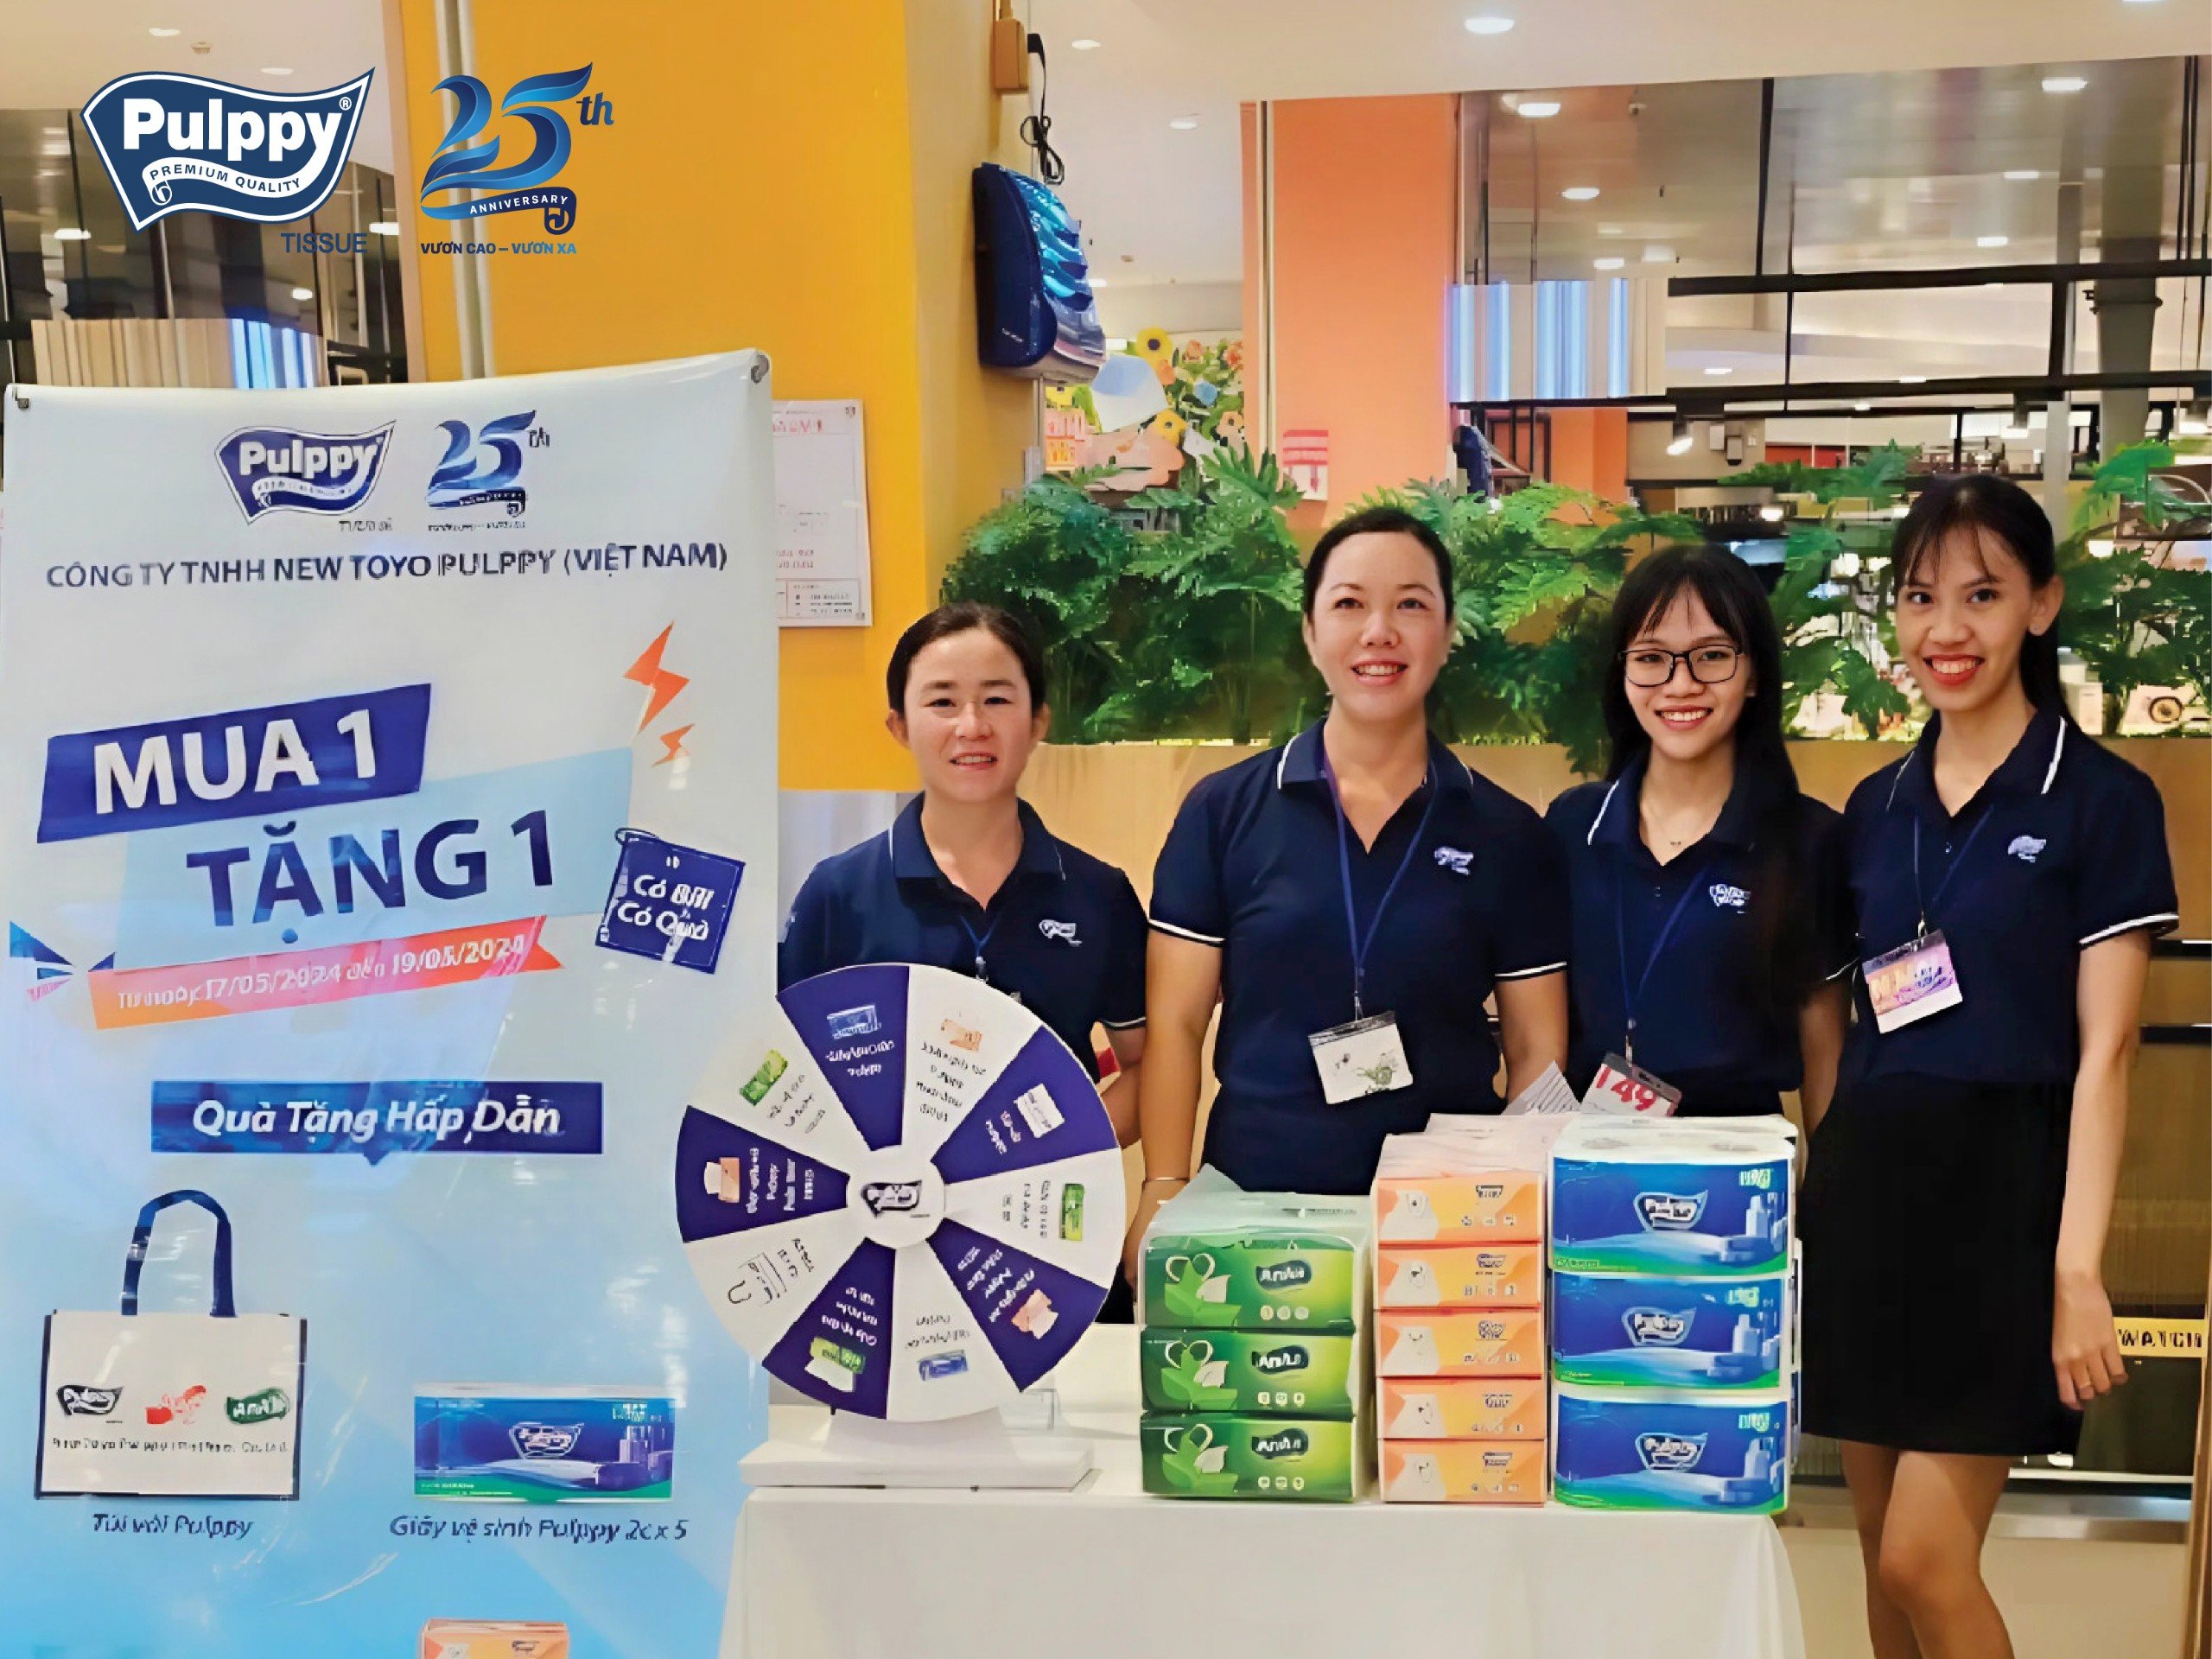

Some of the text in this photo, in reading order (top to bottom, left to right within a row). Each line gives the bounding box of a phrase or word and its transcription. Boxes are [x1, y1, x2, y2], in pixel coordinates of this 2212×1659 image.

[239, 439, 378, 479] Pulppy
[47, 542, 728, 588] CÔNG TY TNHH NEW TOYO PULPPY (VIỆT NAM)
[94, 709, 377, 814] MUA 1
[186, 810, 553, 944] TẶNG 1
[193, 1100, 276, 1136] Quà
[287, 1100, 378, 1143] Tặng
[386, 1094, 465, 1141] Hấp
